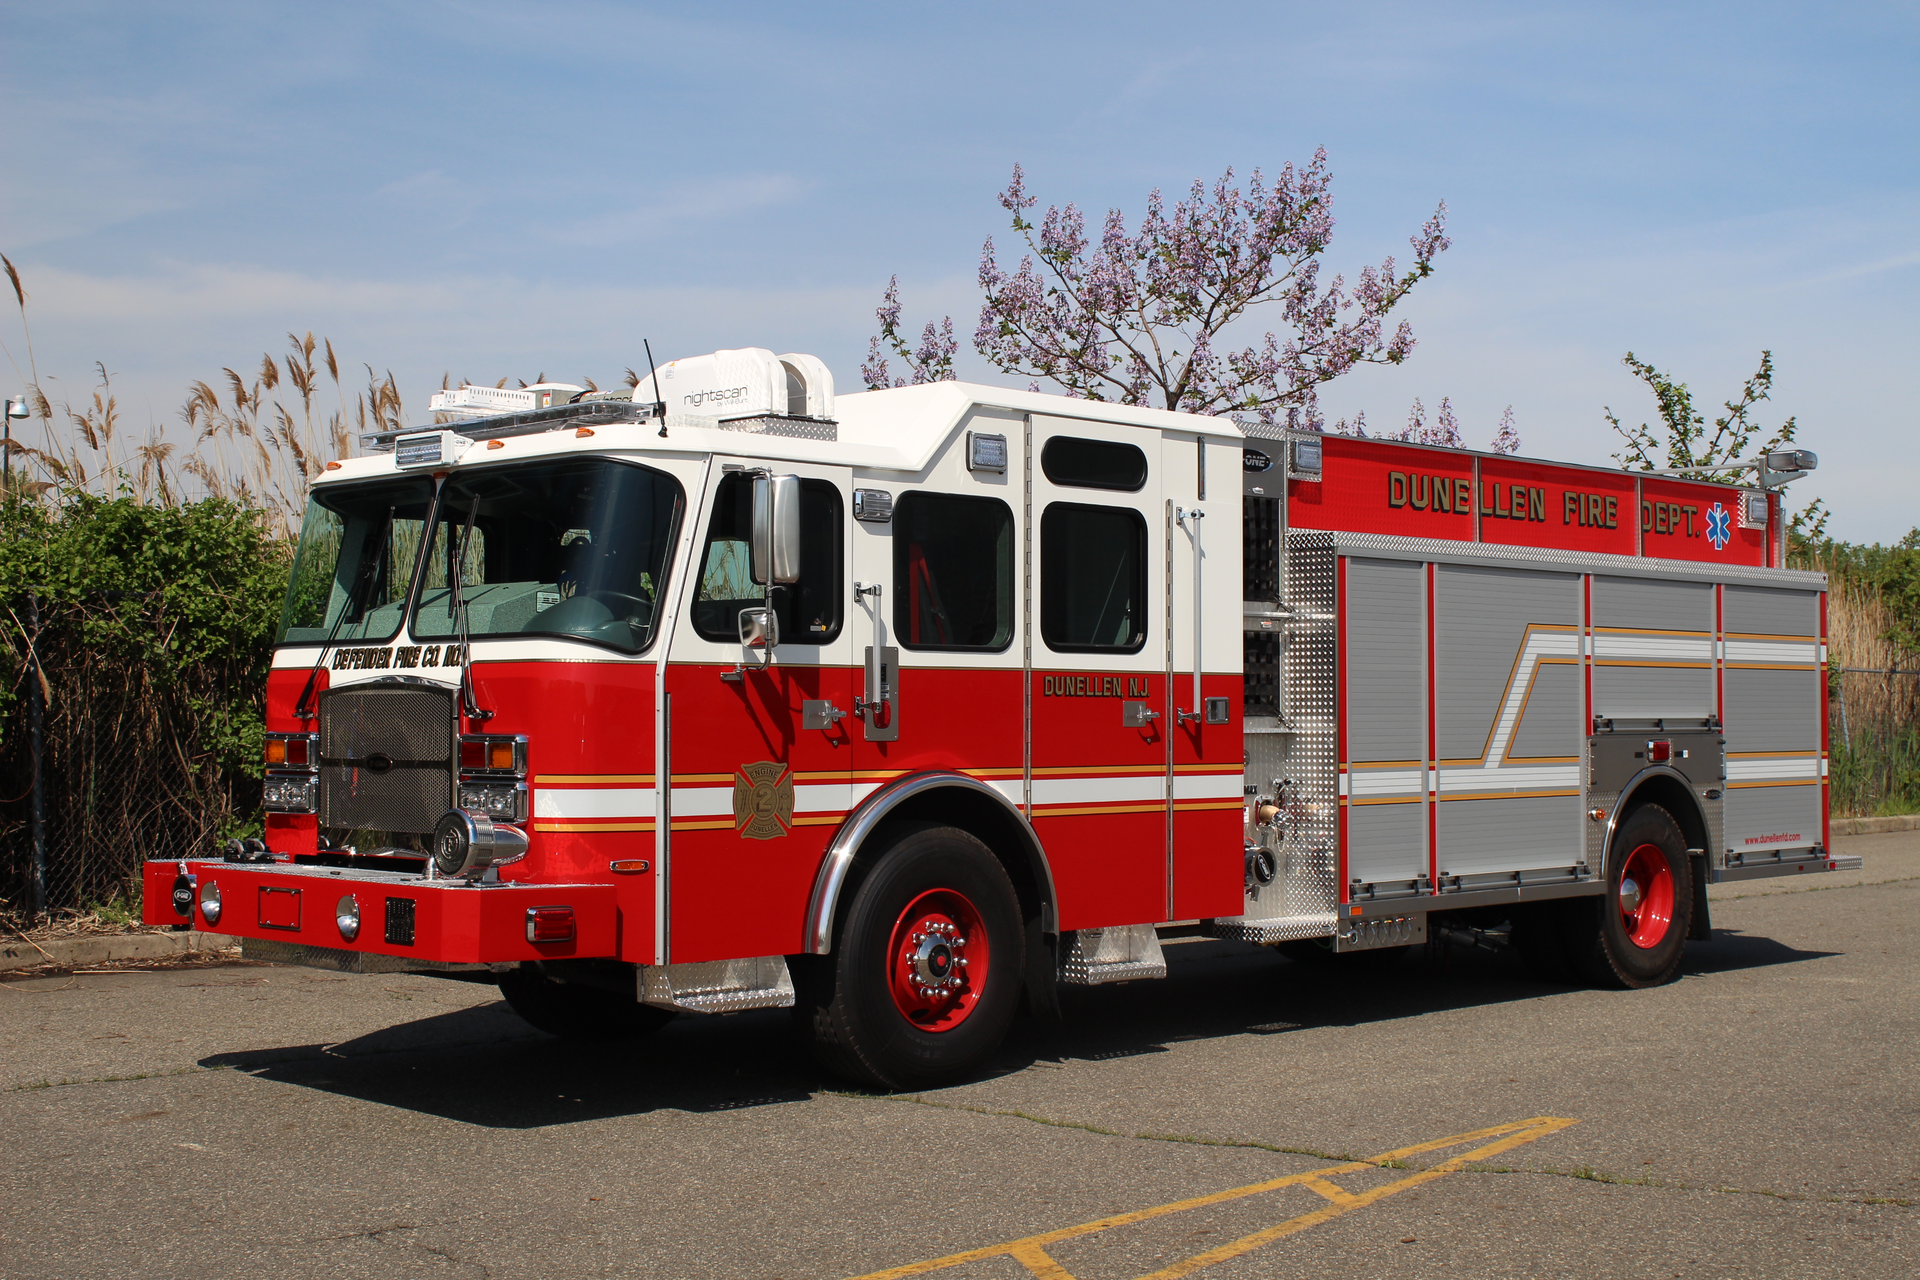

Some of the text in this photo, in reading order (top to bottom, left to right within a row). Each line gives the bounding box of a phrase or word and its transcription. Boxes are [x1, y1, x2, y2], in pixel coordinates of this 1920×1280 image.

[684, 386, 748, 407] nightscan
[1389, 471, 1700, 538] DUNELLEN FIRE DEPT.
[332, 647, 393, 670] DEFENDER
[393, 646, 422, 669] FIRE
[421, 645, 441, 667] CO.
[1044, 675, 1151, 700] DUNELLEN, N.J.
[749, 768, 778, 779] ENGINE
[756, 787, 773, 812] 2
[749, 821, 778, 833] DUNELLEN
[1745, 832, 1801, 845] www.dunellenfd.com
